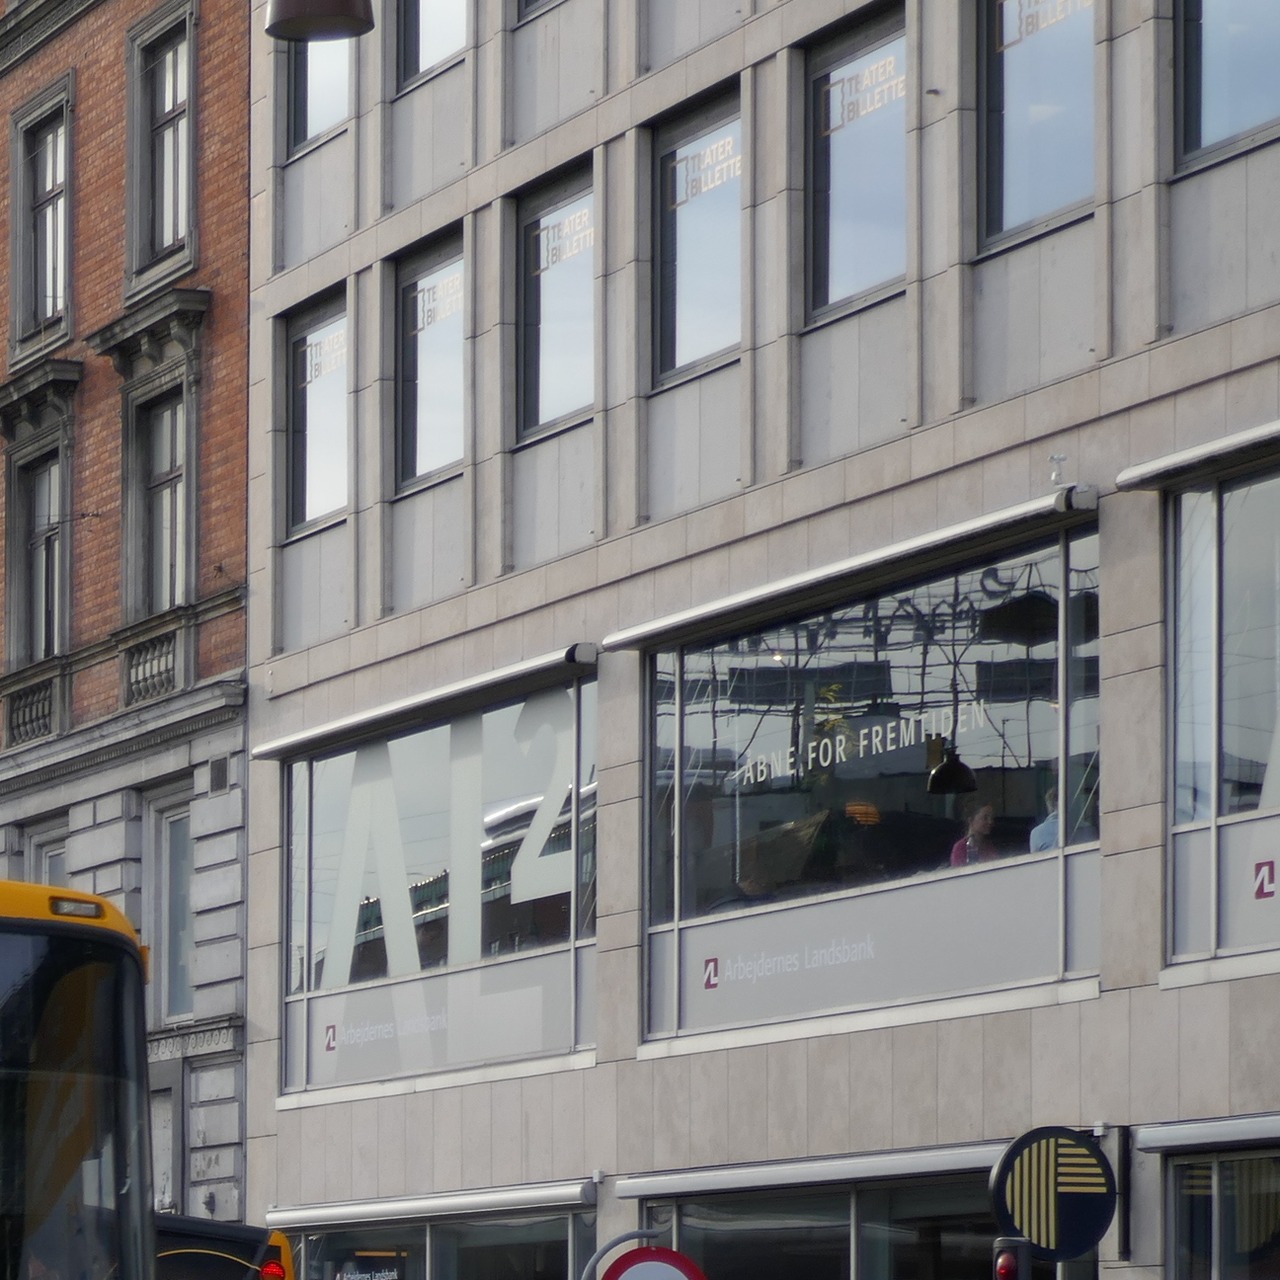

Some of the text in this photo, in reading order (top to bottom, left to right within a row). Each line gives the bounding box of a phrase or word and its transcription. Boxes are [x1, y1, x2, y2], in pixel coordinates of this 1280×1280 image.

[847, 56, 896, 97] TEATER
[743, 698, 986, 786] ÅBNE FOR FREMTIDEN
[724, 950, 800, 984] Arbejdernes
[804, 933, 876, 969] Landsbank
